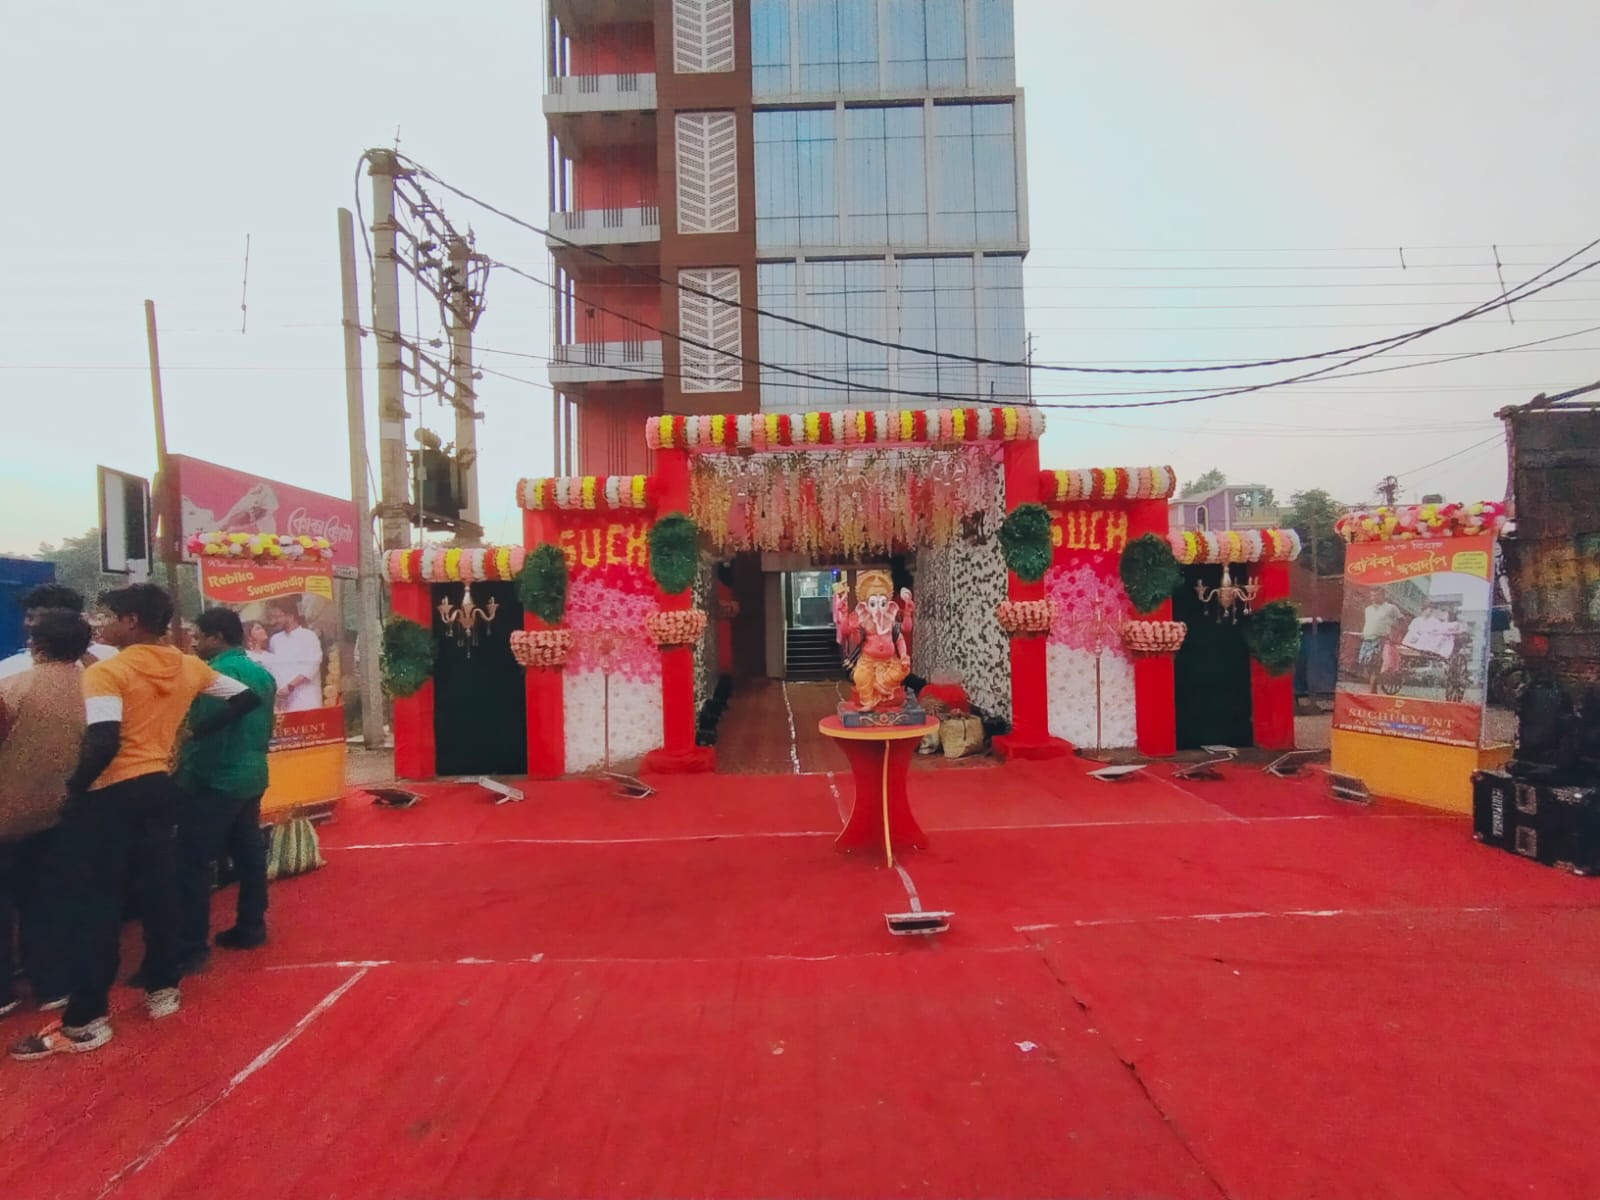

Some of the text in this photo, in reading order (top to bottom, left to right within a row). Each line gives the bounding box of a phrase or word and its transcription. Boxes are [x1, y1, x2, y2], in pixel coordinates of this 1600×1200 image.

[208, 571, 254, 588] Rebika
[283, 722, 327, 736] EVENT
[1401, 712, 1455, 729] EVENT
